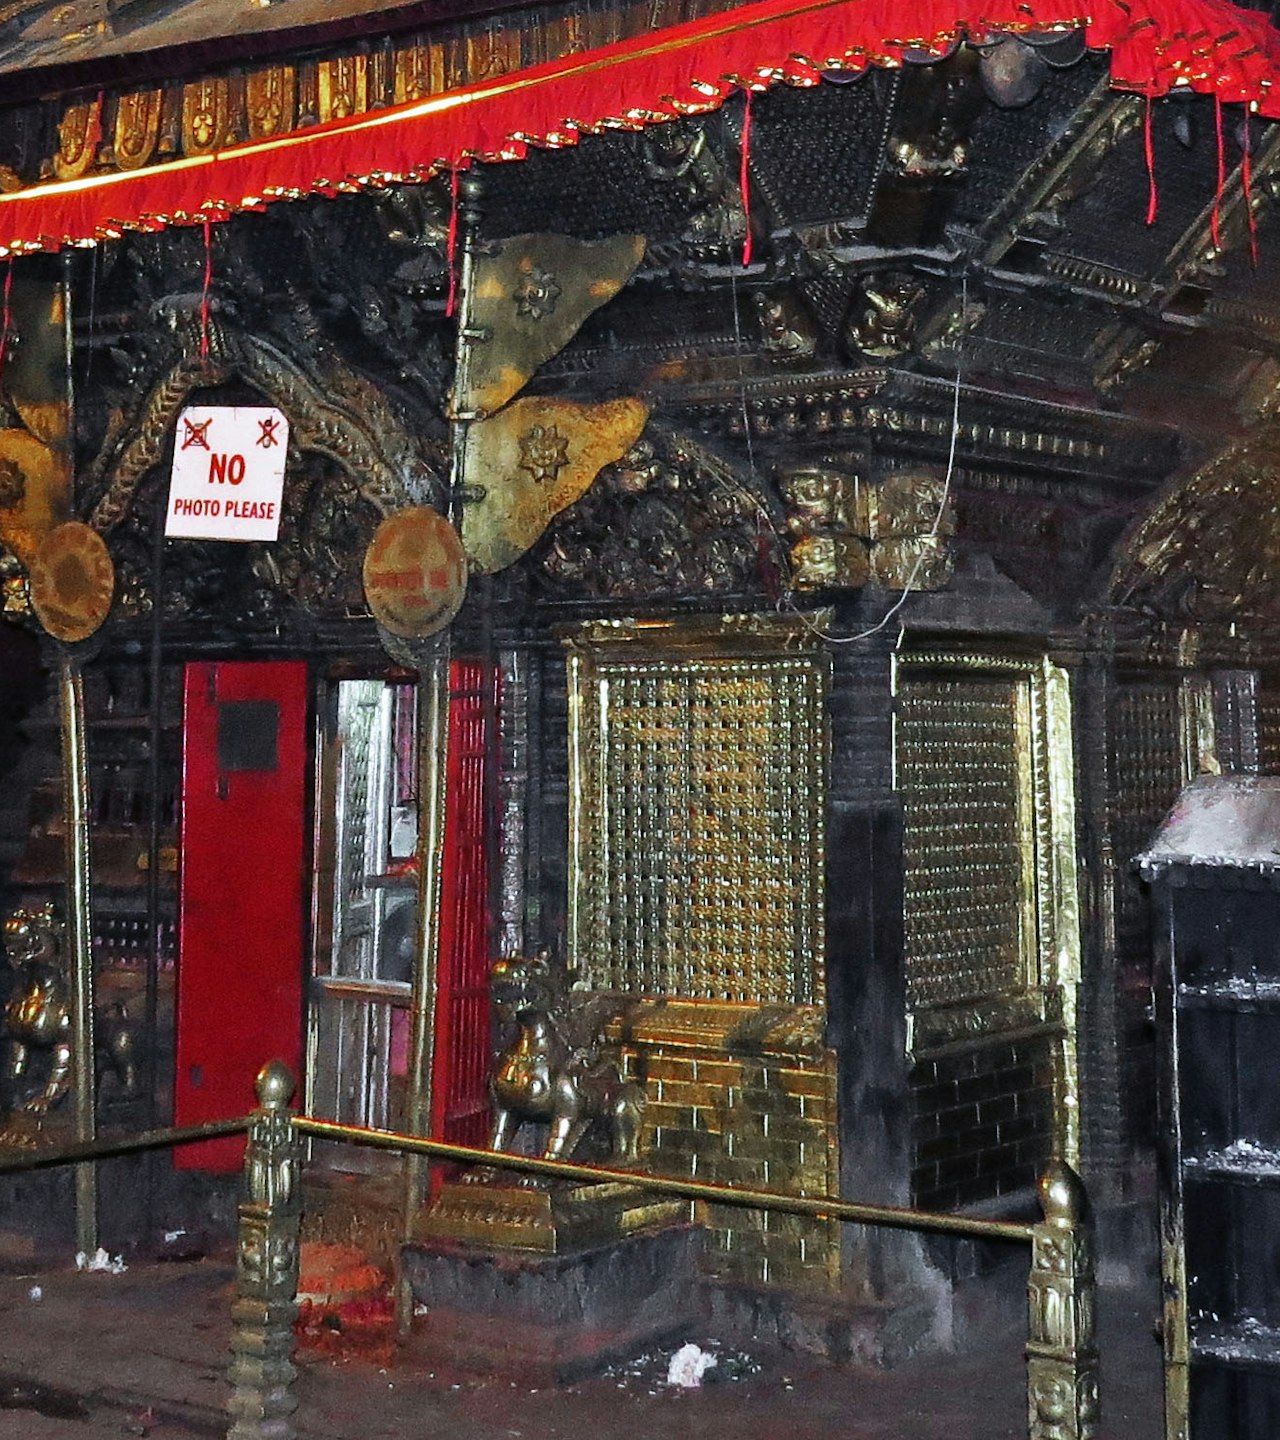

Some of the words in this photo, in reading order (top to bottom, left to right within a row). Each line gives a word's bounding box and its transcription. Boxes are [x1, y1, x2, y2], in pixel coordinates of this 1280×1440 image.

[208, 453, 246, 486] NO
[174, 498, 221, 517] PHOTO
[224, 500, 276, 520] PLEASE
